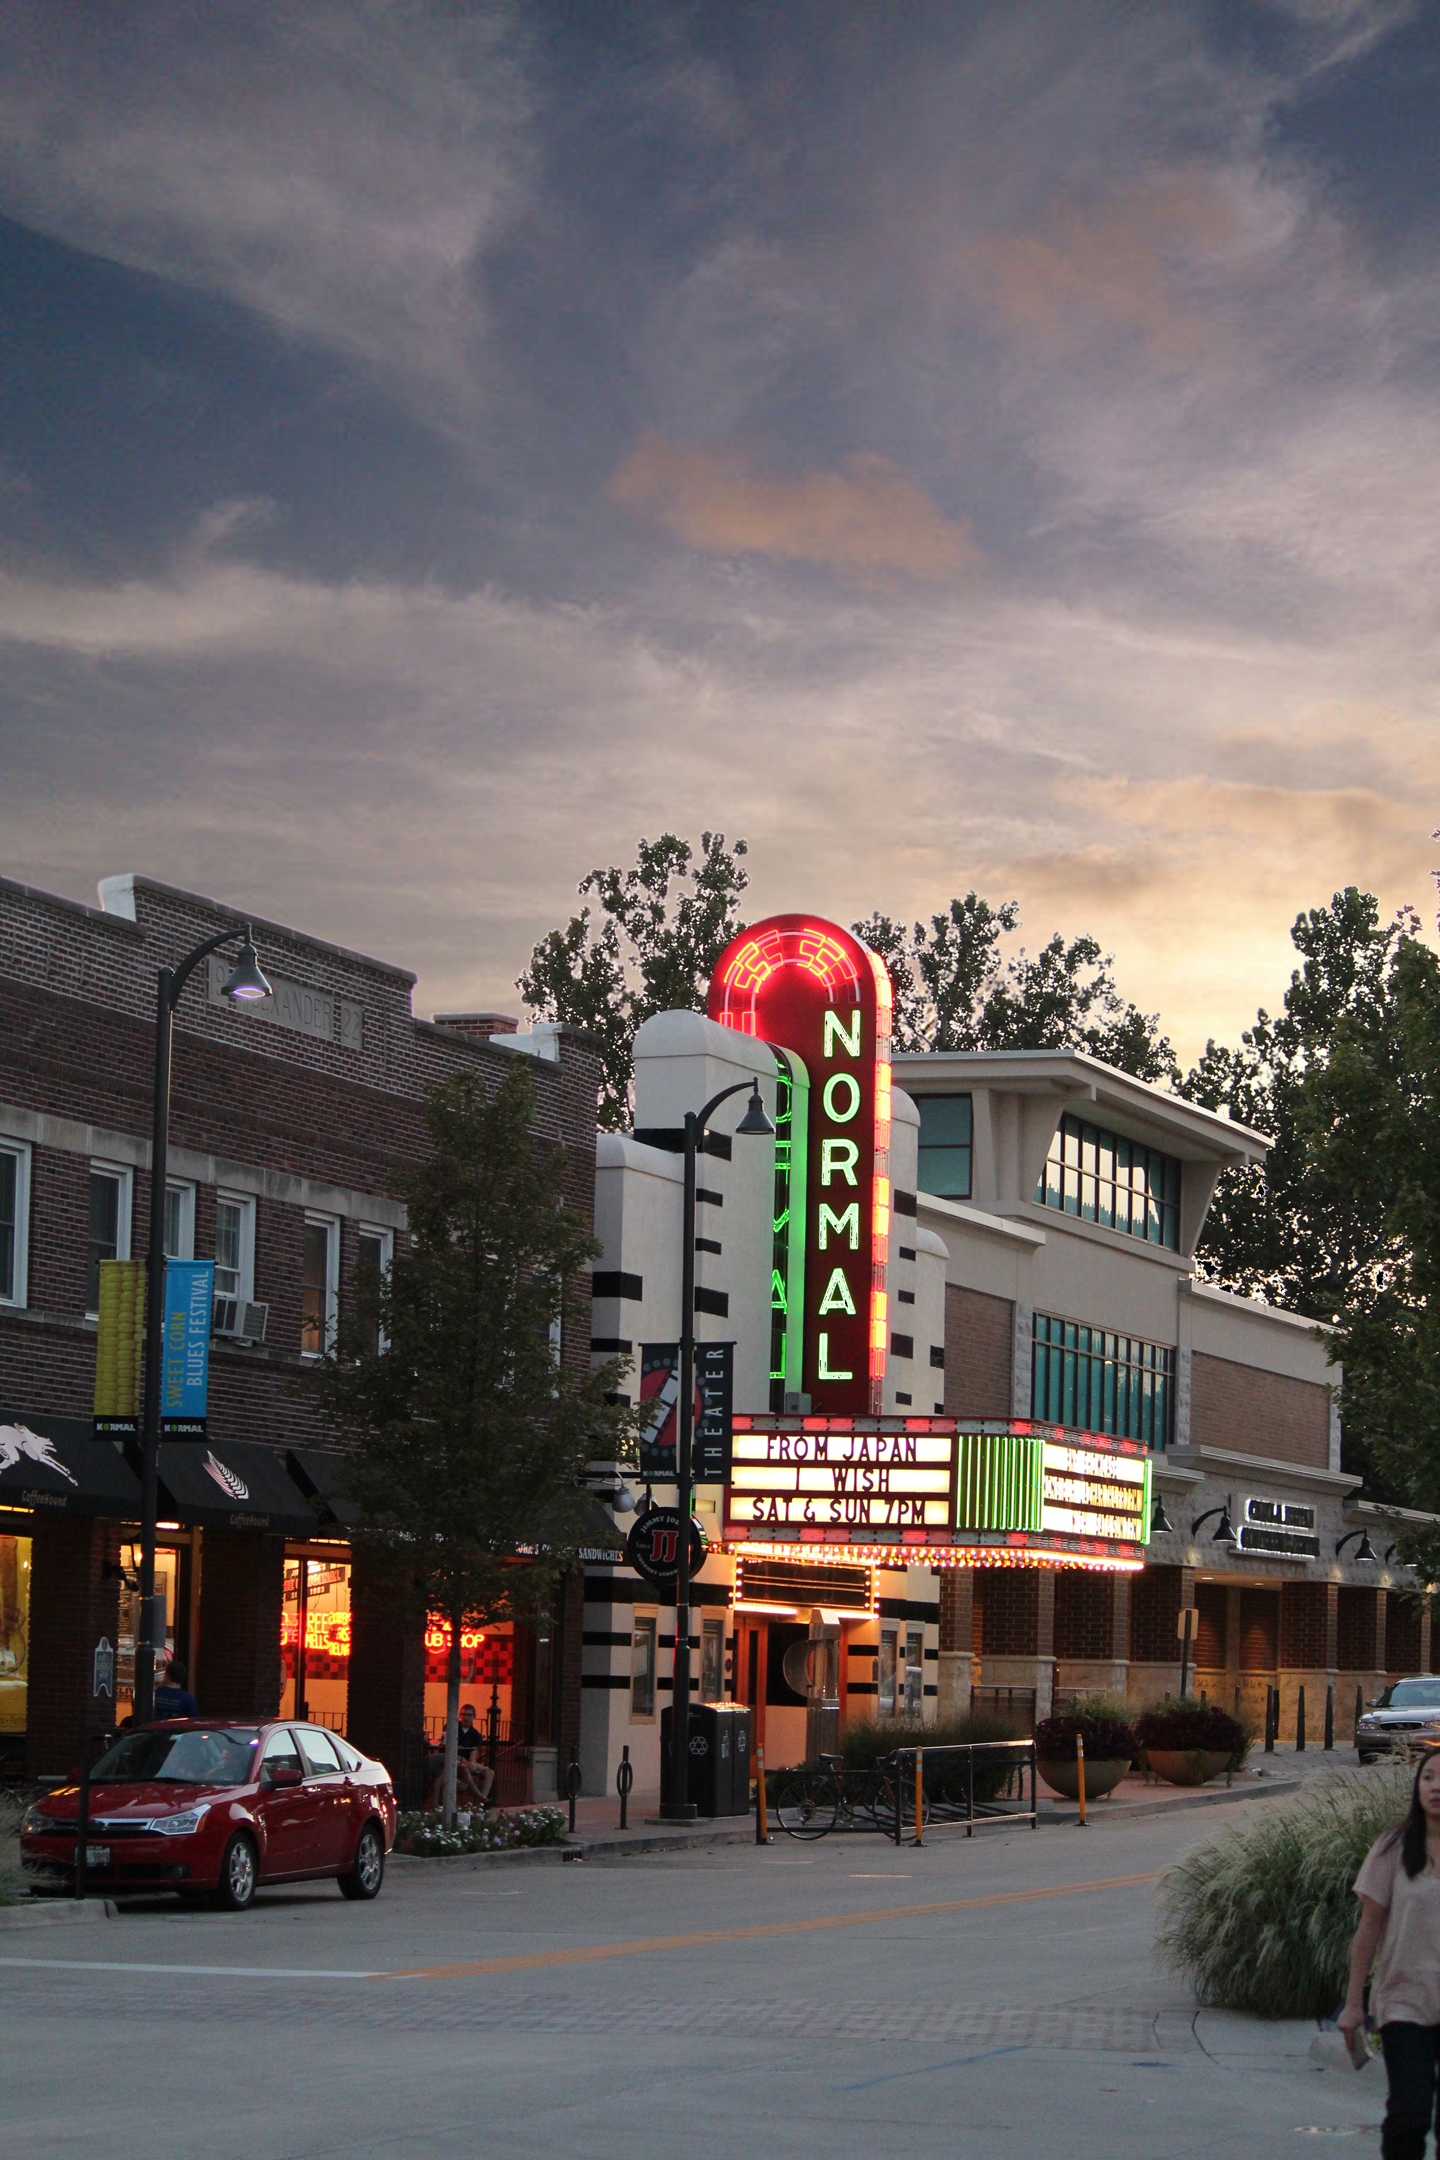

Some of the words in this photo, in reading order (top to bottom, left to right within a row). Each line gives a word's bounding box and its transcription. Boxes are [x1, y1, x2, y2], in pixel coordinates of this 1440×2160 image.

[818, 1009, 861, 1380] NORMAL
[188, 1270, 209, 1334] FESTIVAL
[169, 1311, 186, 1351] CORN
[186, 1341, 205, 1386] BLUES
[166, 1357, 183, 1407] SWEET
[704, 1348, 724, 1477] THEATER
[767, 1436, 828, 1461] FROM
[842, 1437, 917, 1462] JAPAN
[795, 1467, 801, 1491] I
[831, 1468, 889, 1492] WISH
[640, 1515, 665, 1534] JIMMY
[752, 1497, 790, 1521] SAT
[803, 1499, 816, 1522] &
[829, 1499, 871, 1523] SUN
[883, 1500, 926, 1525] 7PM
[578, 1547, 624, 1562] SANDWICHES
[650, 1530, 679, 1562] JJ
[636, 1553, 658, 1576] GOURMET
[659, 1568, 679, 1577] SANDW
[306, 1612, 329, 1634] REE
[304, 1633, 330, 1650] MELLS
[425, 1633, 443, 1647] UB
